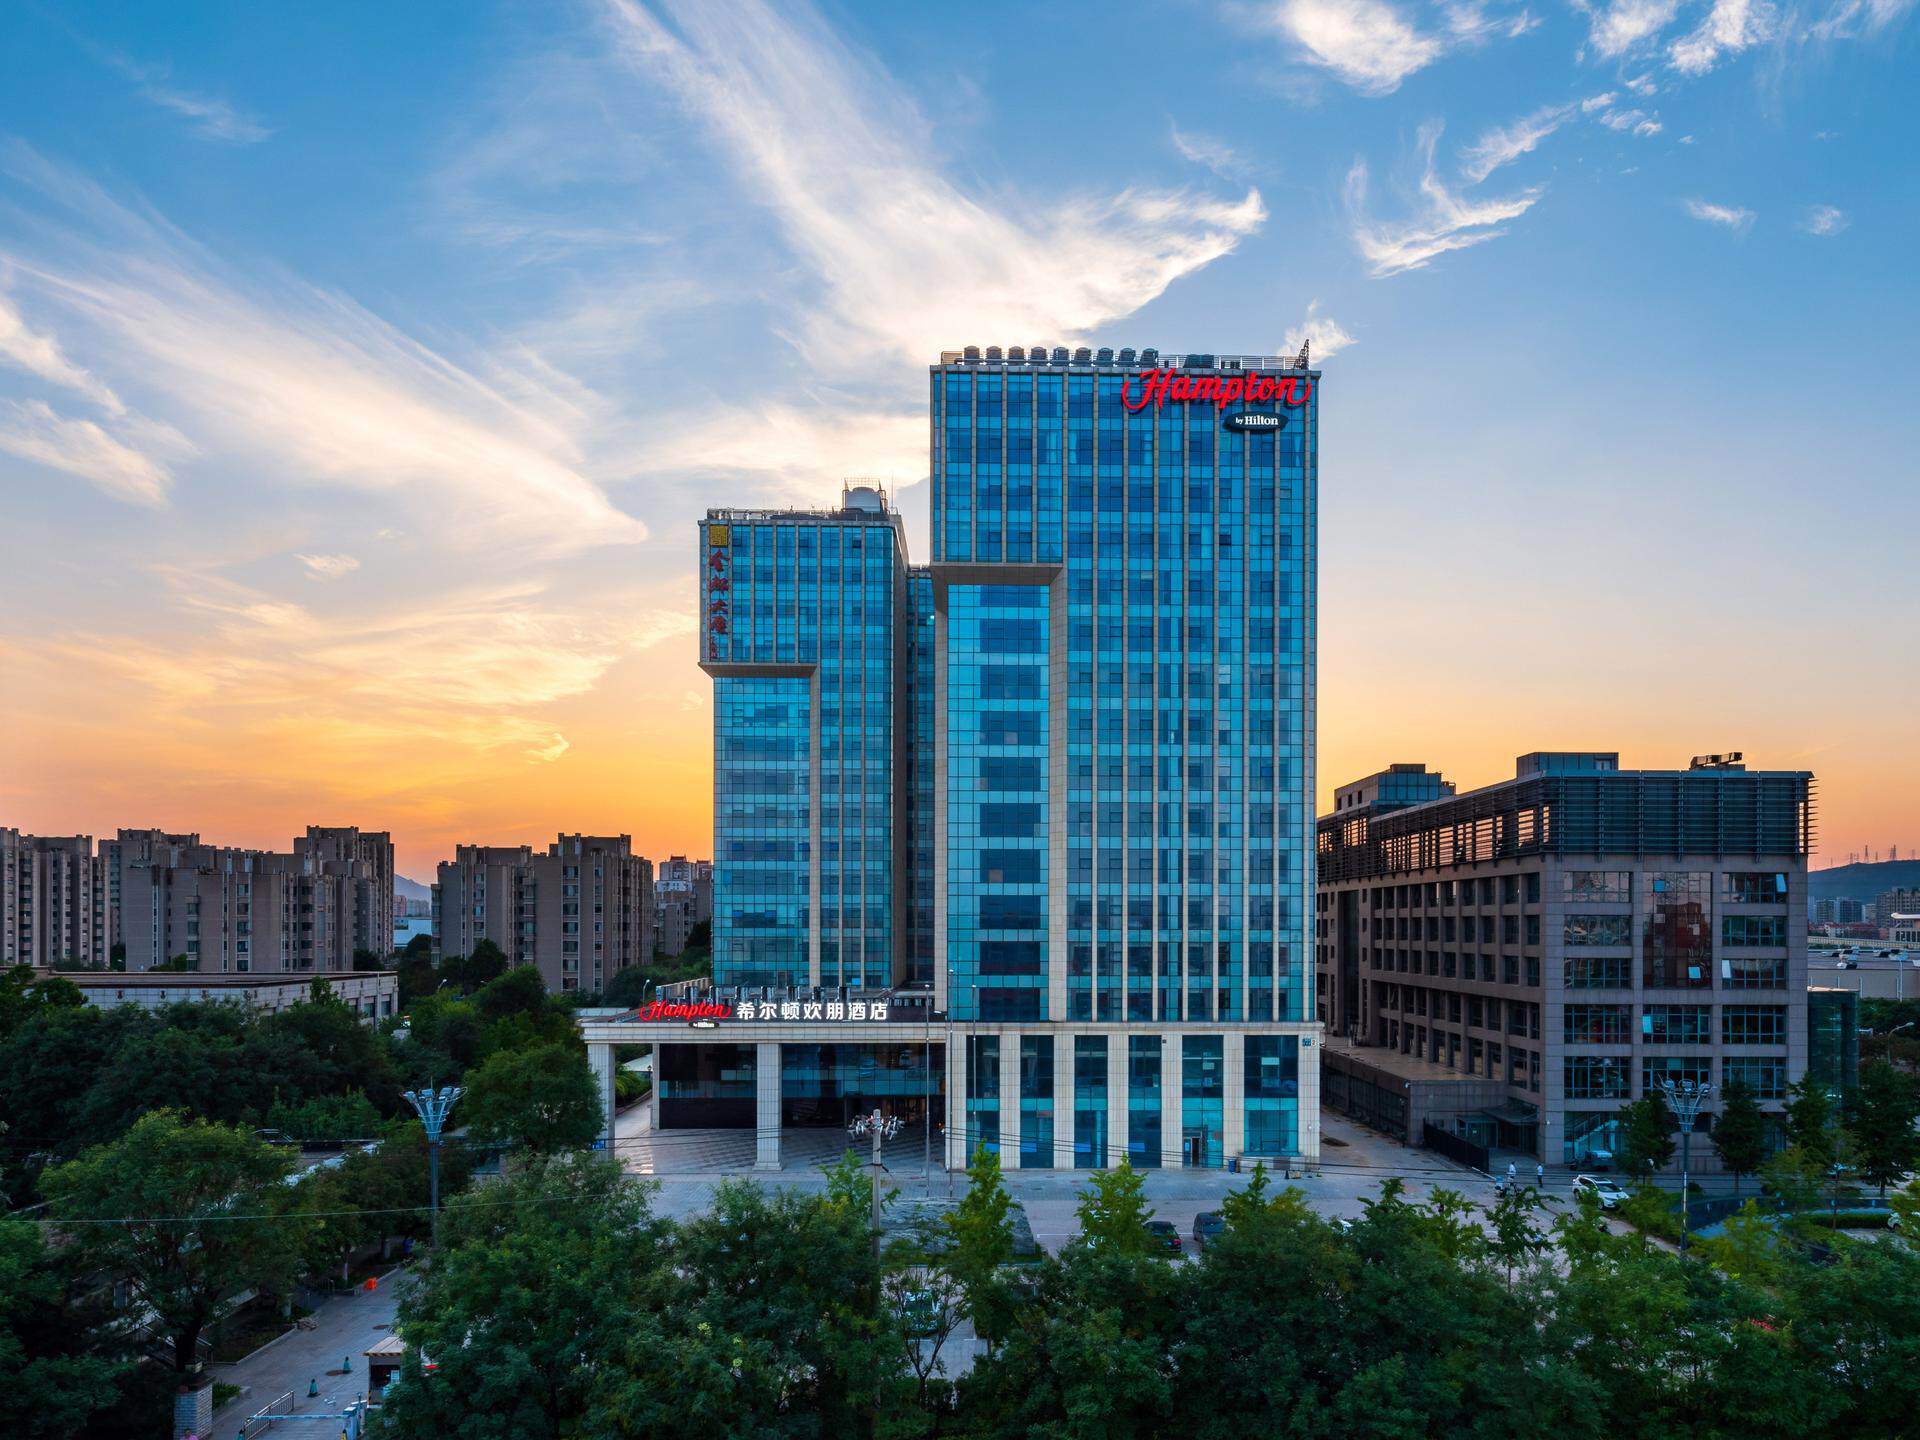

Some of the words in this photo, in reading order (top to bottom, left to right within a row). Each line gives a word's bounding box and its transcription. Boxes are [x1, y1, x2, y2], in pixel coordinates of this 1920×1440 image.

[1122, 368, 1311, 409] Hampton
[1235, 417, 1244, 425] by
[1244, 415, 1279, 425] Hilton
[640, 1000, 731, 1021] Hampton
[736, 1002, 888, 1020] 希尔顿欢朋酒店
